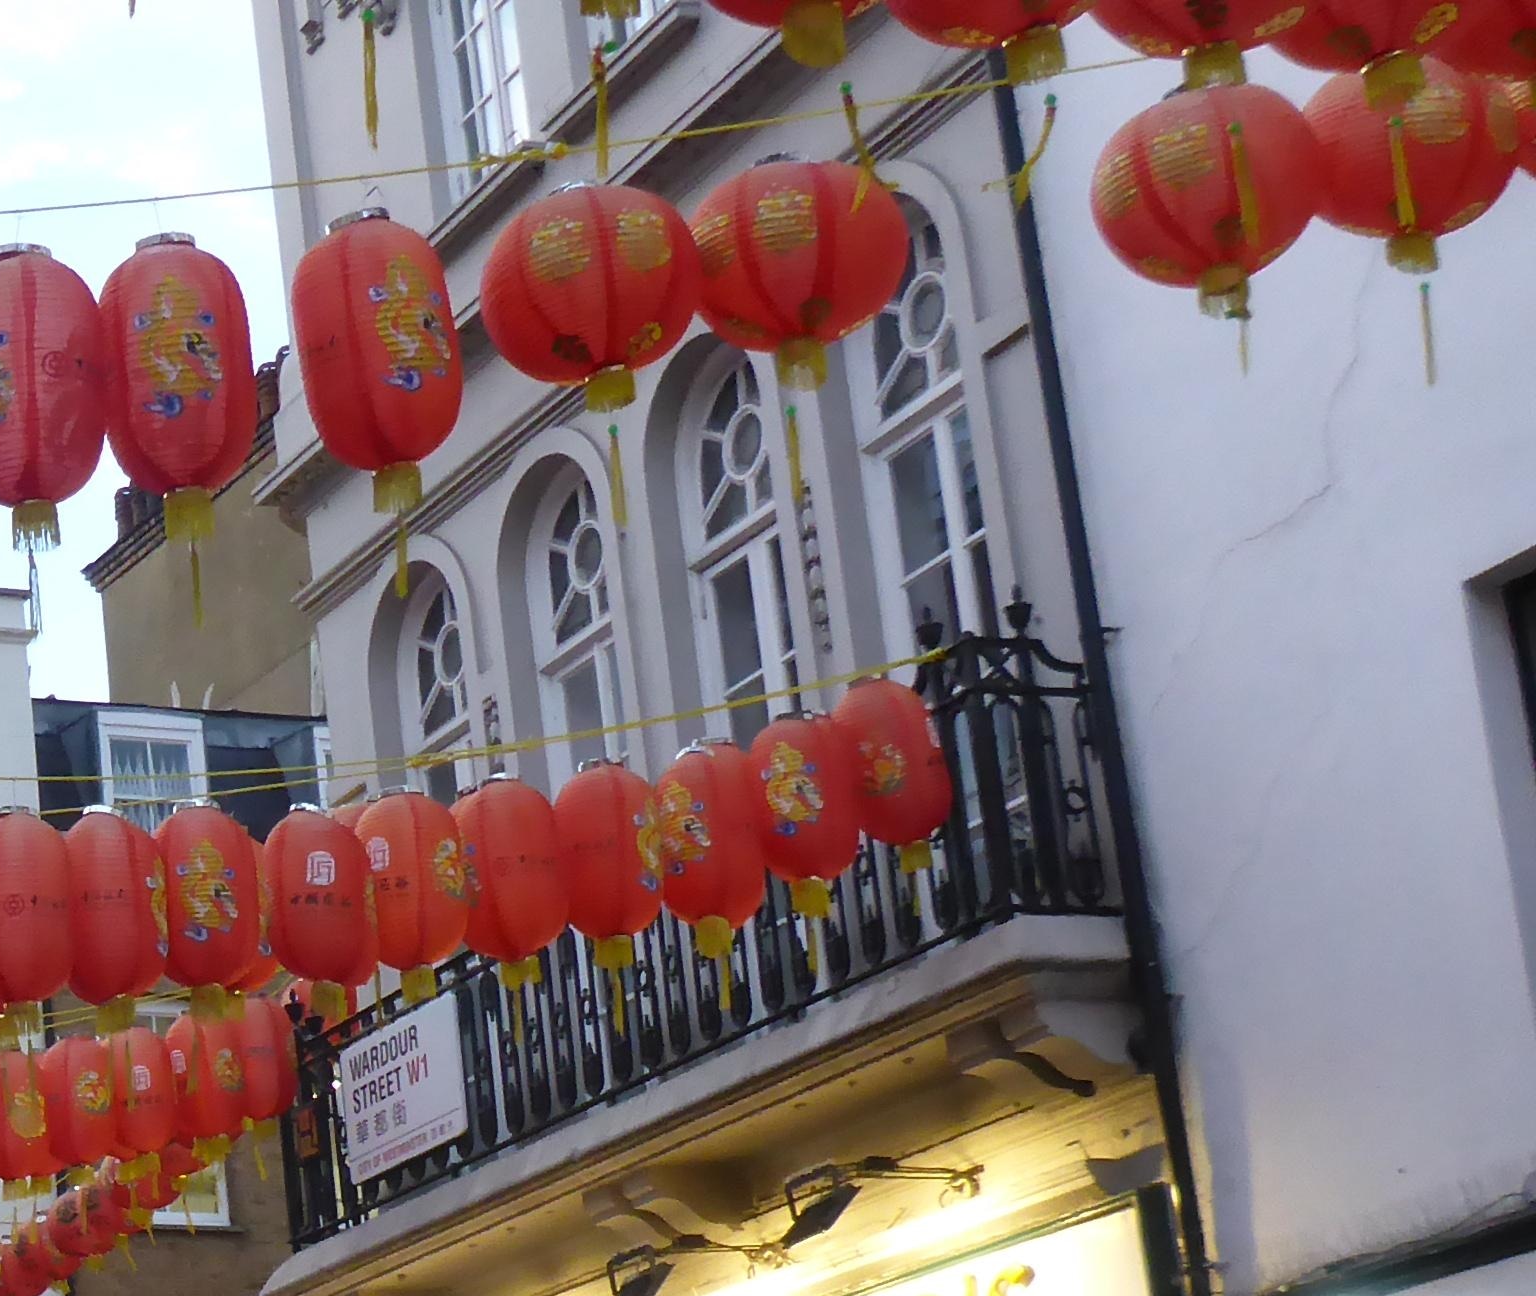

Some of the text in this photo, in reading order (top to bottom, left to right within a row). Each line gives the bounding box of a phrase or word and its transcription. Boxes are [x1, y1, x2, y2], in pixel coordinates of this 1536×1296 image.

[349, 1025, 418, 1081] WARDOUR
[352, 1054, 428, 1114] STREET W1
